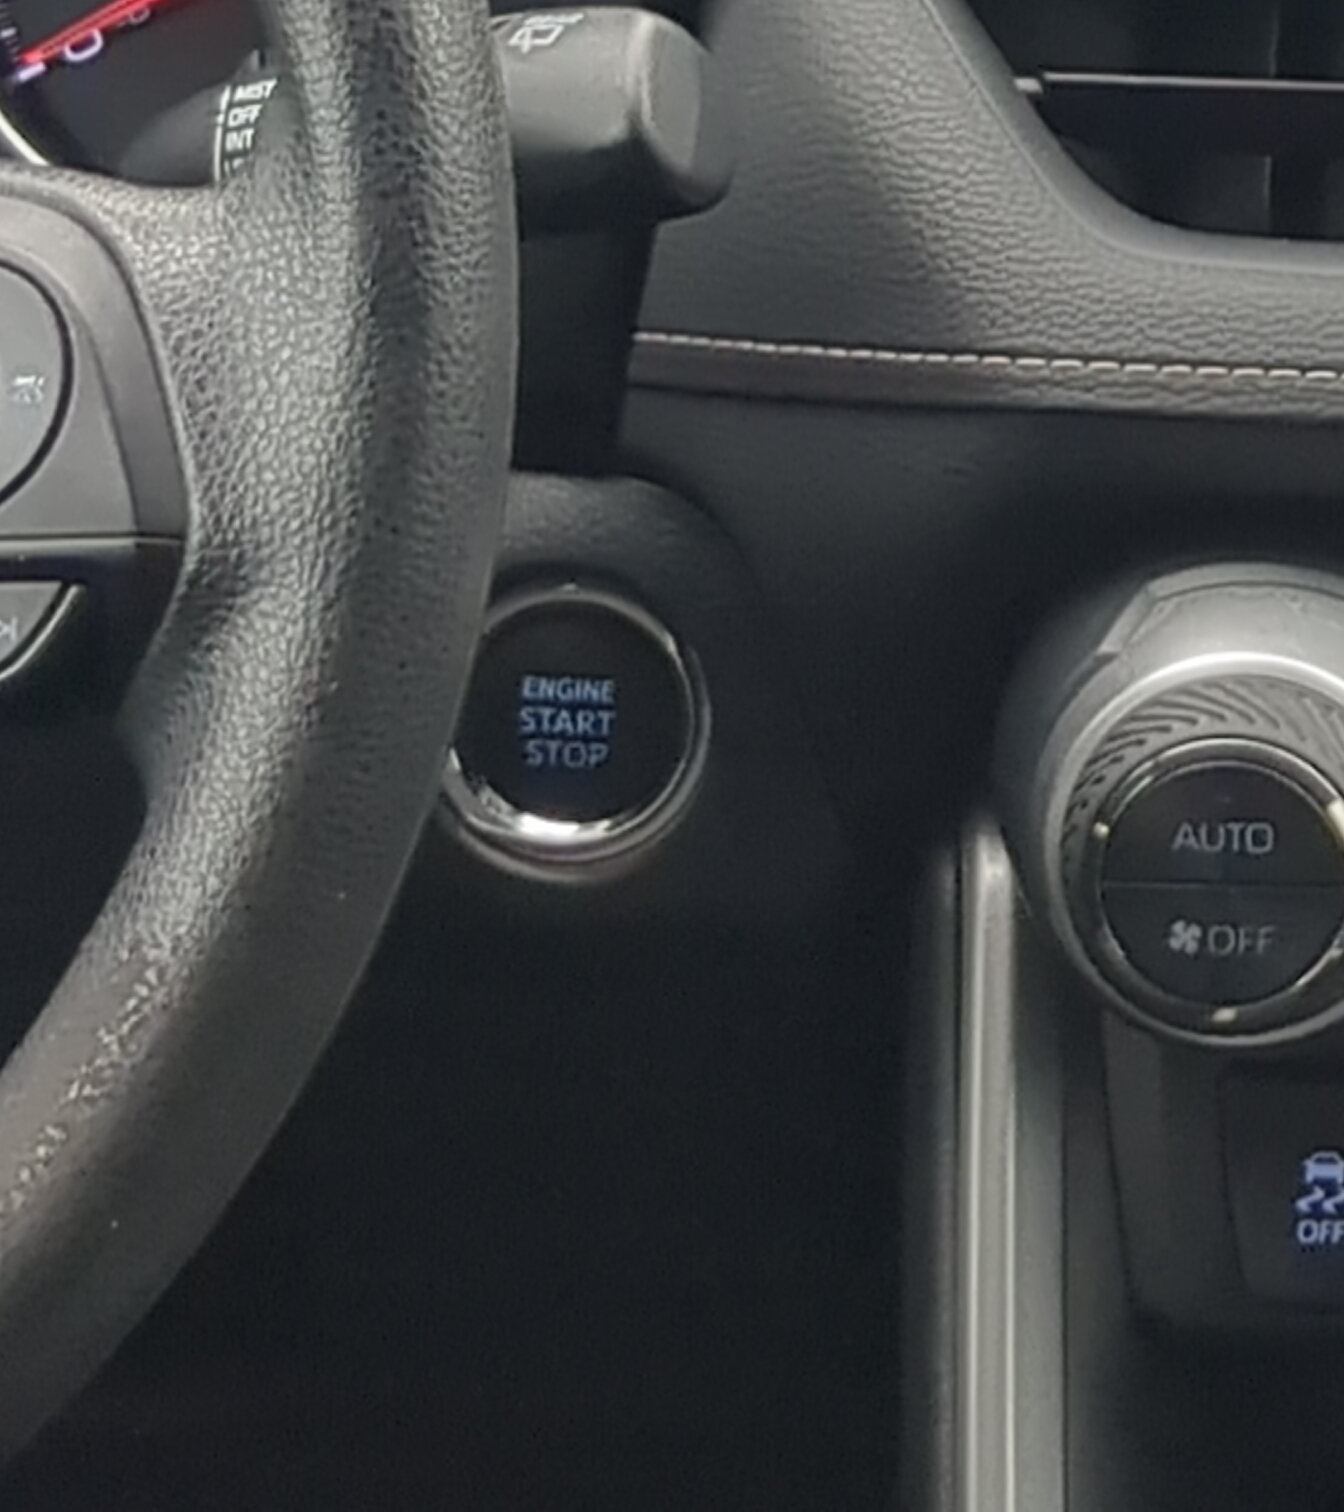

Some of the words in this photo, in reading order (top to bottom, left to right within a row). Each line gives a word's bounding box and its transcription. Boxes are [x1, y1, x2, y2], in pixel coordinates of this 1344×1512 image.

[523, 676, 613, 702] ENGINE
[520, 707, 615, 736] START
[526, 740, 608, 768] STOP
[1172, 823, 1274, 853] AUTO
[1207, 928, 1273, 954] OFF
